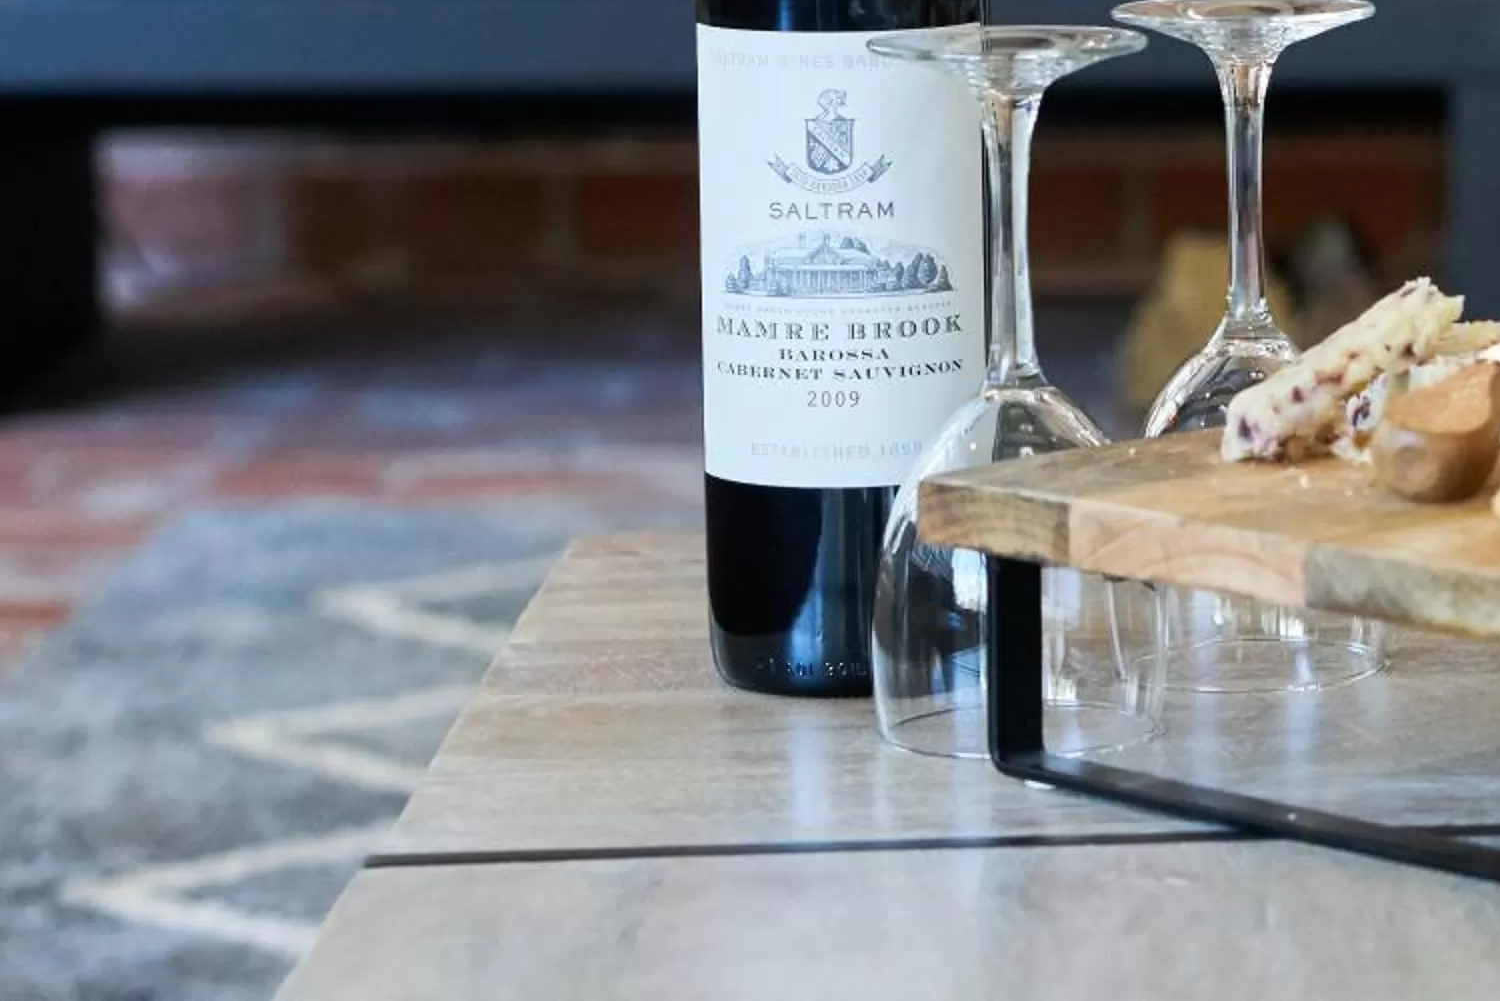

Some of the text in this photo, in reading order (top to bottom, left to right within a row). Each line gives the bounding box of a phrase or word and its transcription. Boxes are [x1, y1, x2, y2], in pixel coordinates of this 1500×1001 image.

[769, 201, 895, 220] SALTRAM
[716, 313, 965, 340] MAMRE BROOK
[779, 348, 890, 360] BAROSSA
[716, 358, 965, 381] CABERNET SAUVIGNON
[807, 390, 862, 408] 2009
